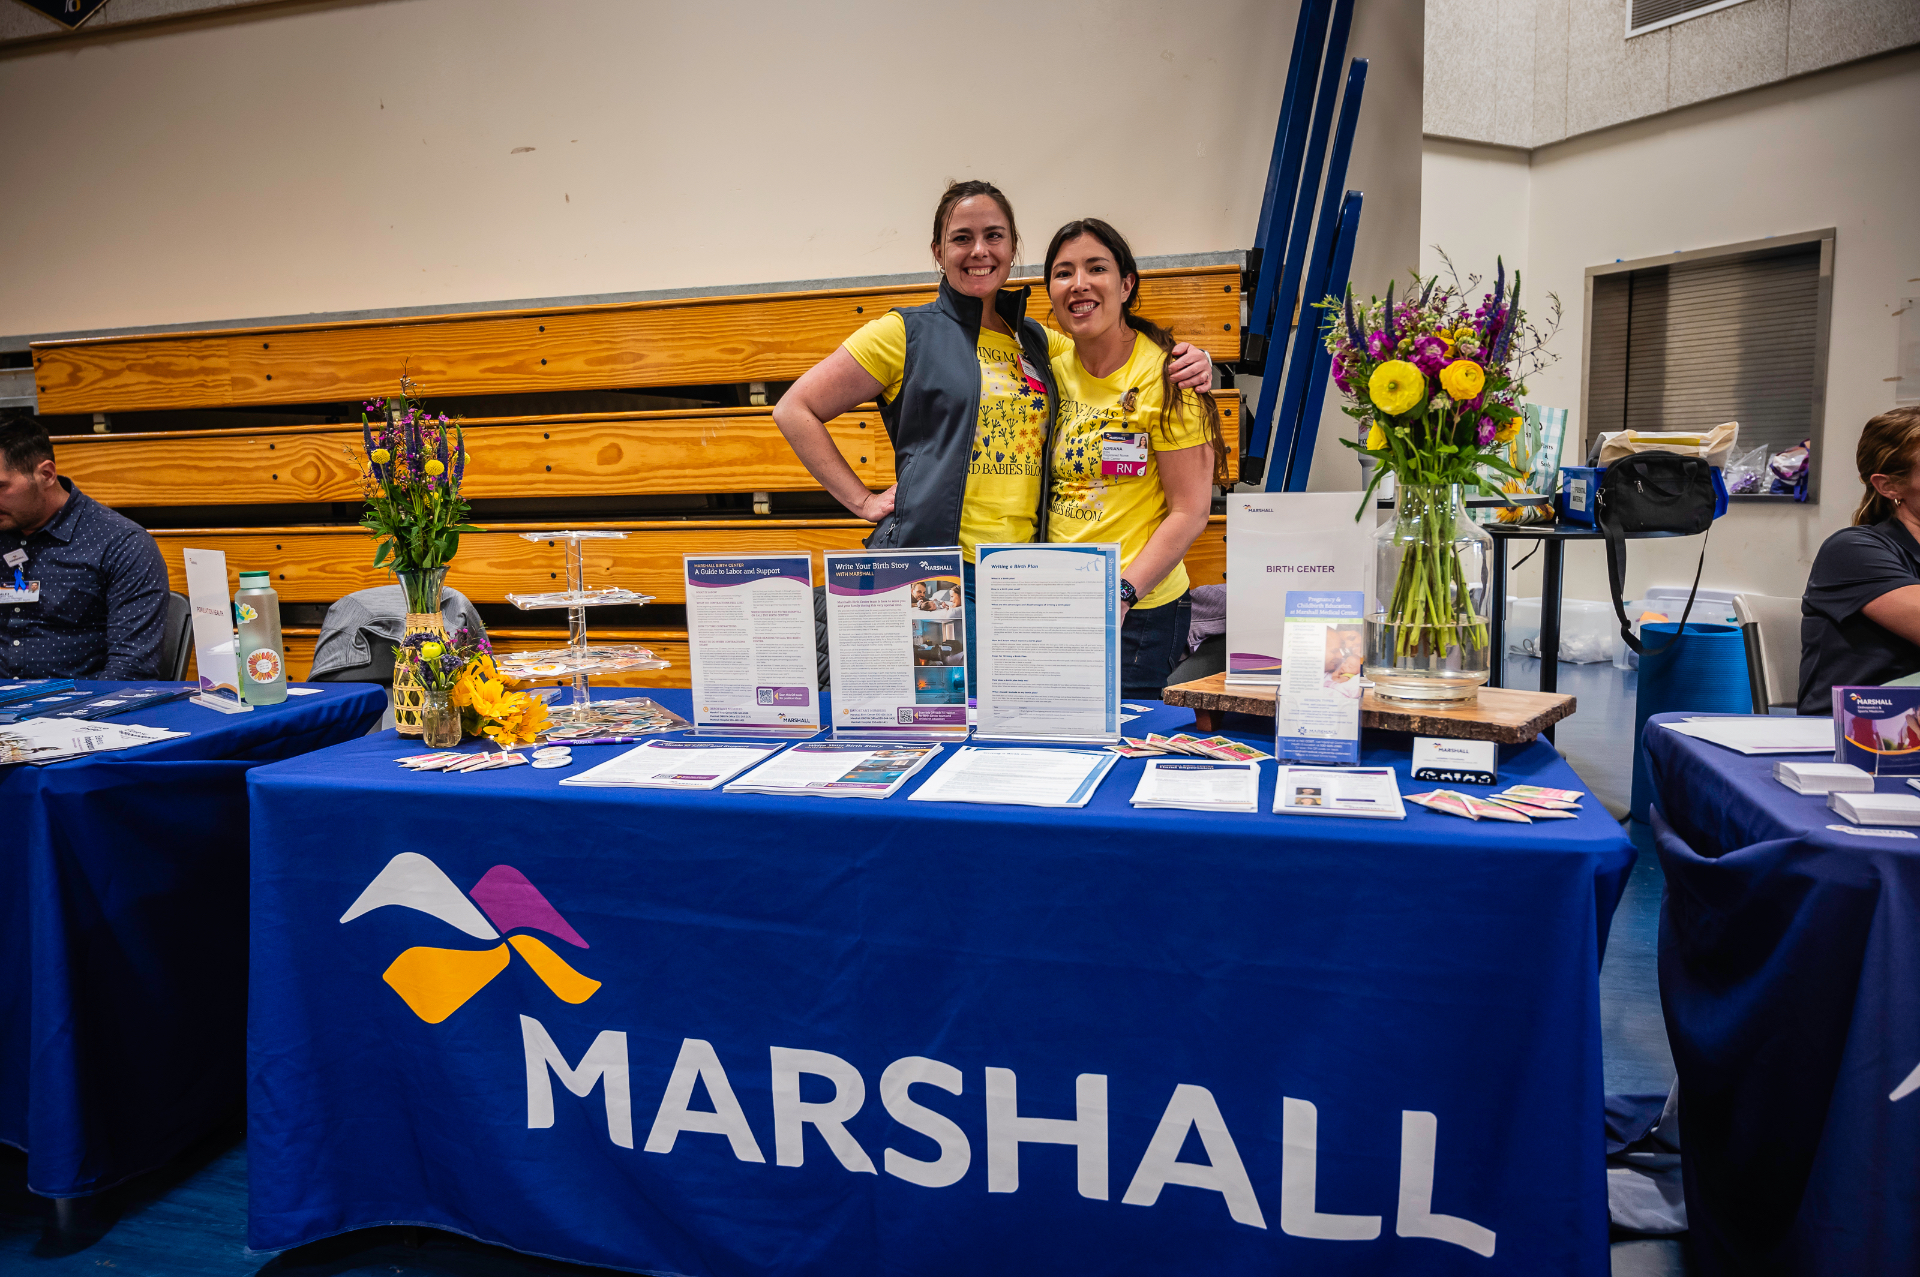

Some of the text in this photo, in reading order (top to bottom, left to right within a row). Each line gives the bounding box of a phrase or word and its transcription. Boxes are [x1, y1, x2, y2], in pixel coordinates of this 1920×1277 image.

[982, 463, 1023, 475] BABIES
[1117, 463, 1132, 474] RN
[1065, 506, 1103, 521] BLOOM
[756, 568, 780, 576] Support
[891, 562, 909, 571] Story
[520, 1014, 1496, 1257] MARSHALL
